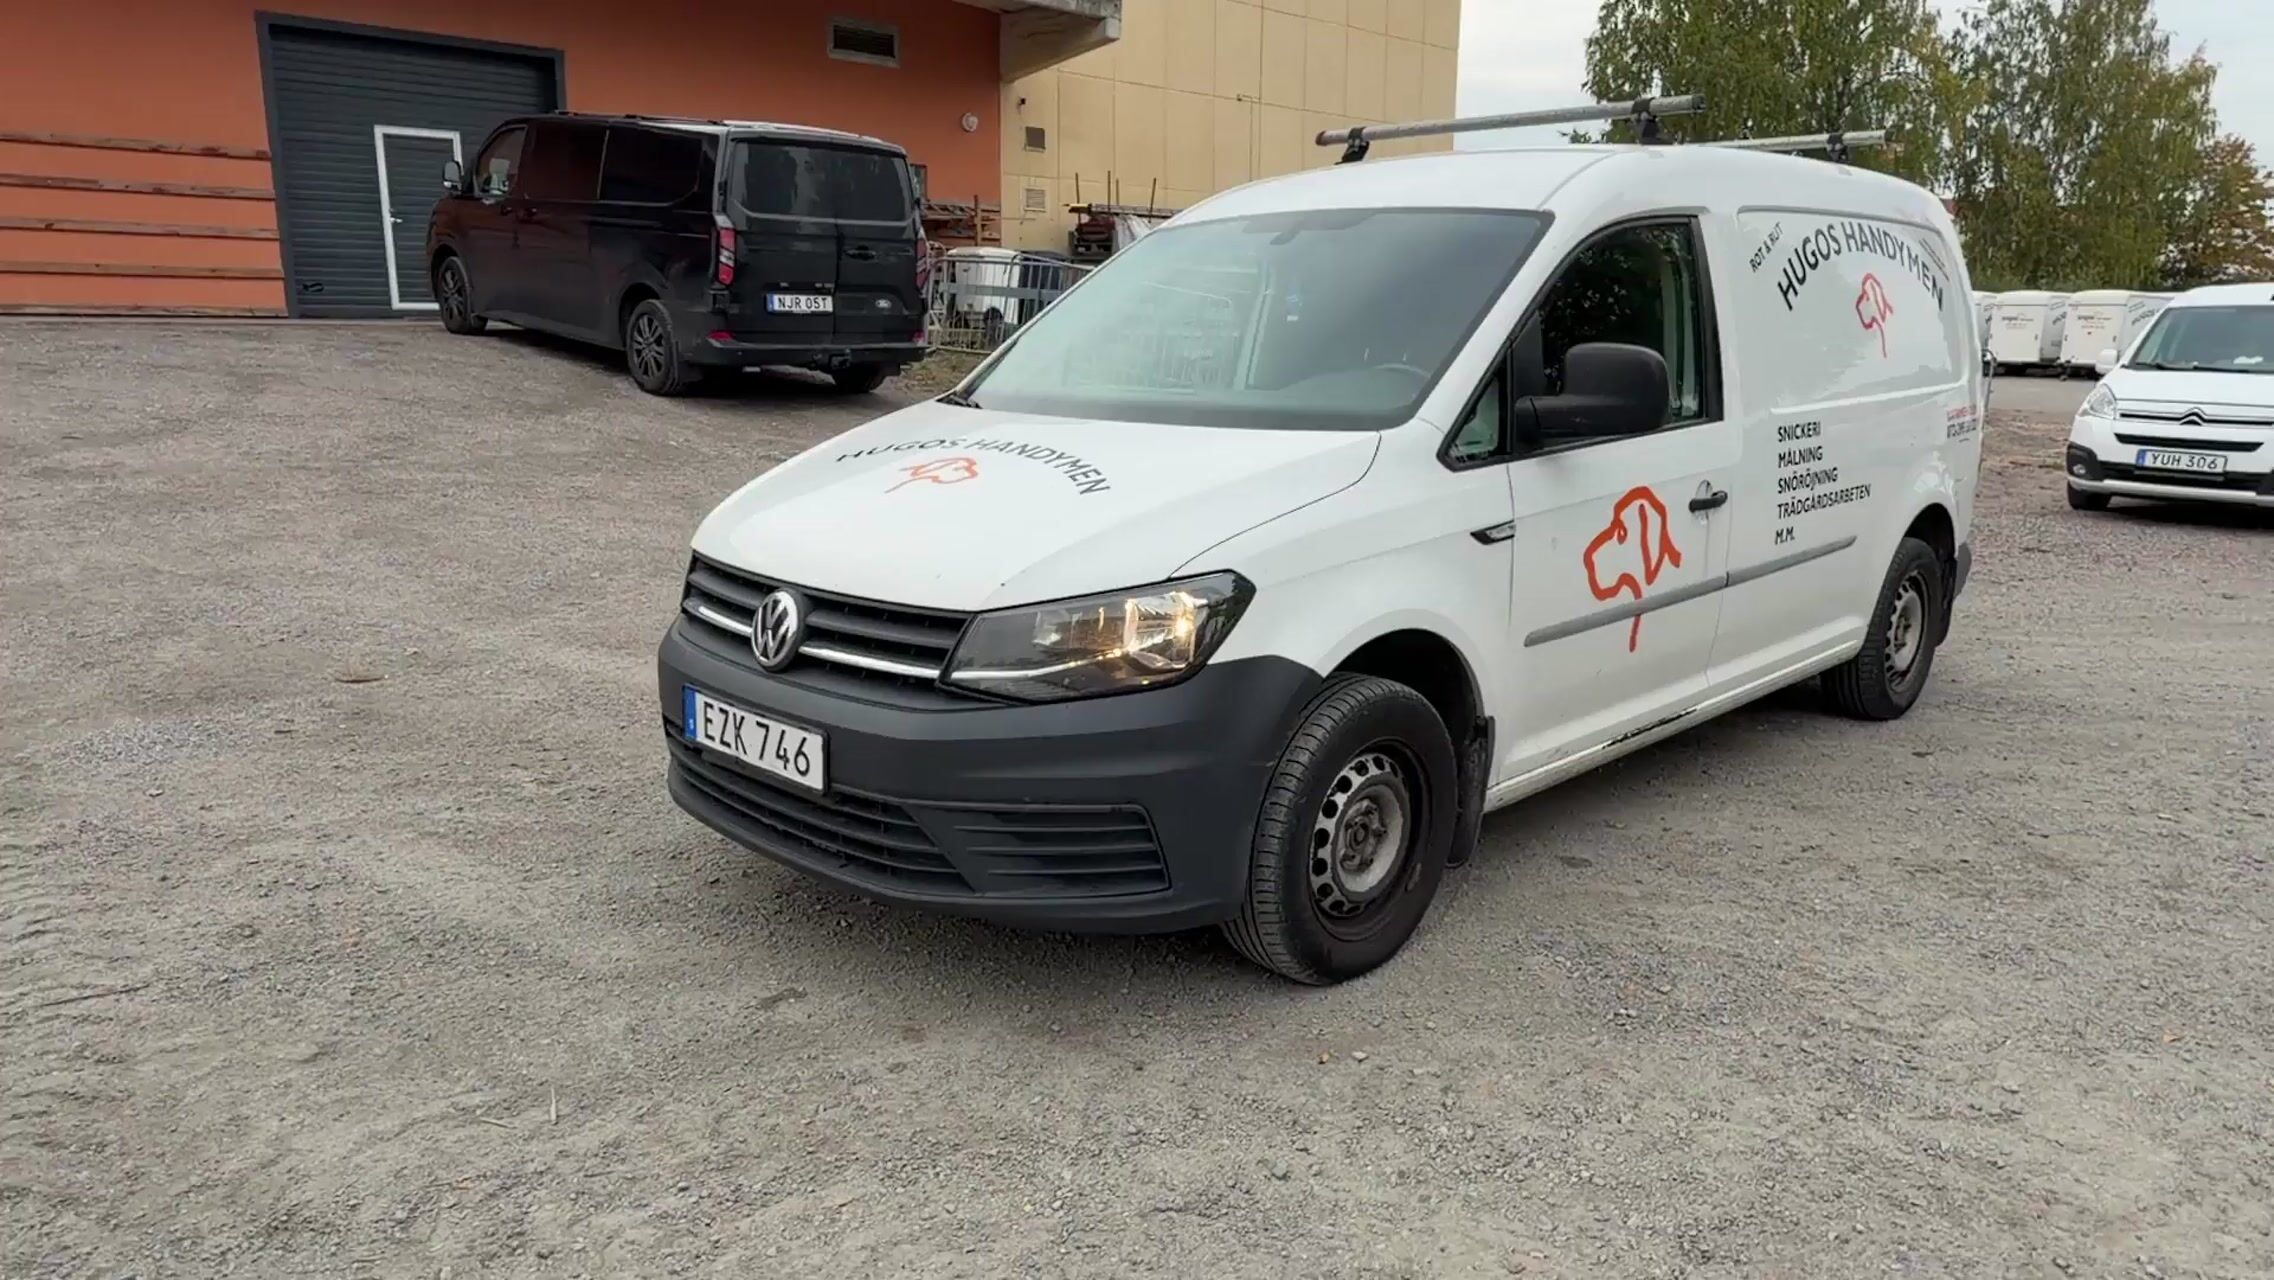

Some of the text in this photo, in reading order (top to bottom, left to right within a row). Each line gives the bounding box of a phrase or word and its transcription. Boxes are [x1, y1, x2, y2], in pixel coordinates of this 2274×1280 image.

[1749, 246, 1766, 272] ROT
[1768, 221, 1784, 246] RUT
[1777, 224, 1842, 311] HUGOS
[1840, 221, 1944, 311] HANDYMEN
[777, 296, 802, 309] NJR
[1777, 421, 1822, 443] SNICKERI
[835, 438, 1111, 495] HUGOS HANDYMEN
[1778, 446, 1824, 468] MÅLNING
[2151, 453, 2218, 470] YUH 306
[1777, 467, 1839, 494] SNÖRÖJNING
[1777, 484, 1872, 519] TRÄDGÅRDSARBETEN
[1774, 526, 1796, 545] M.M.
[703, 700, 811, 776] EZK 746
